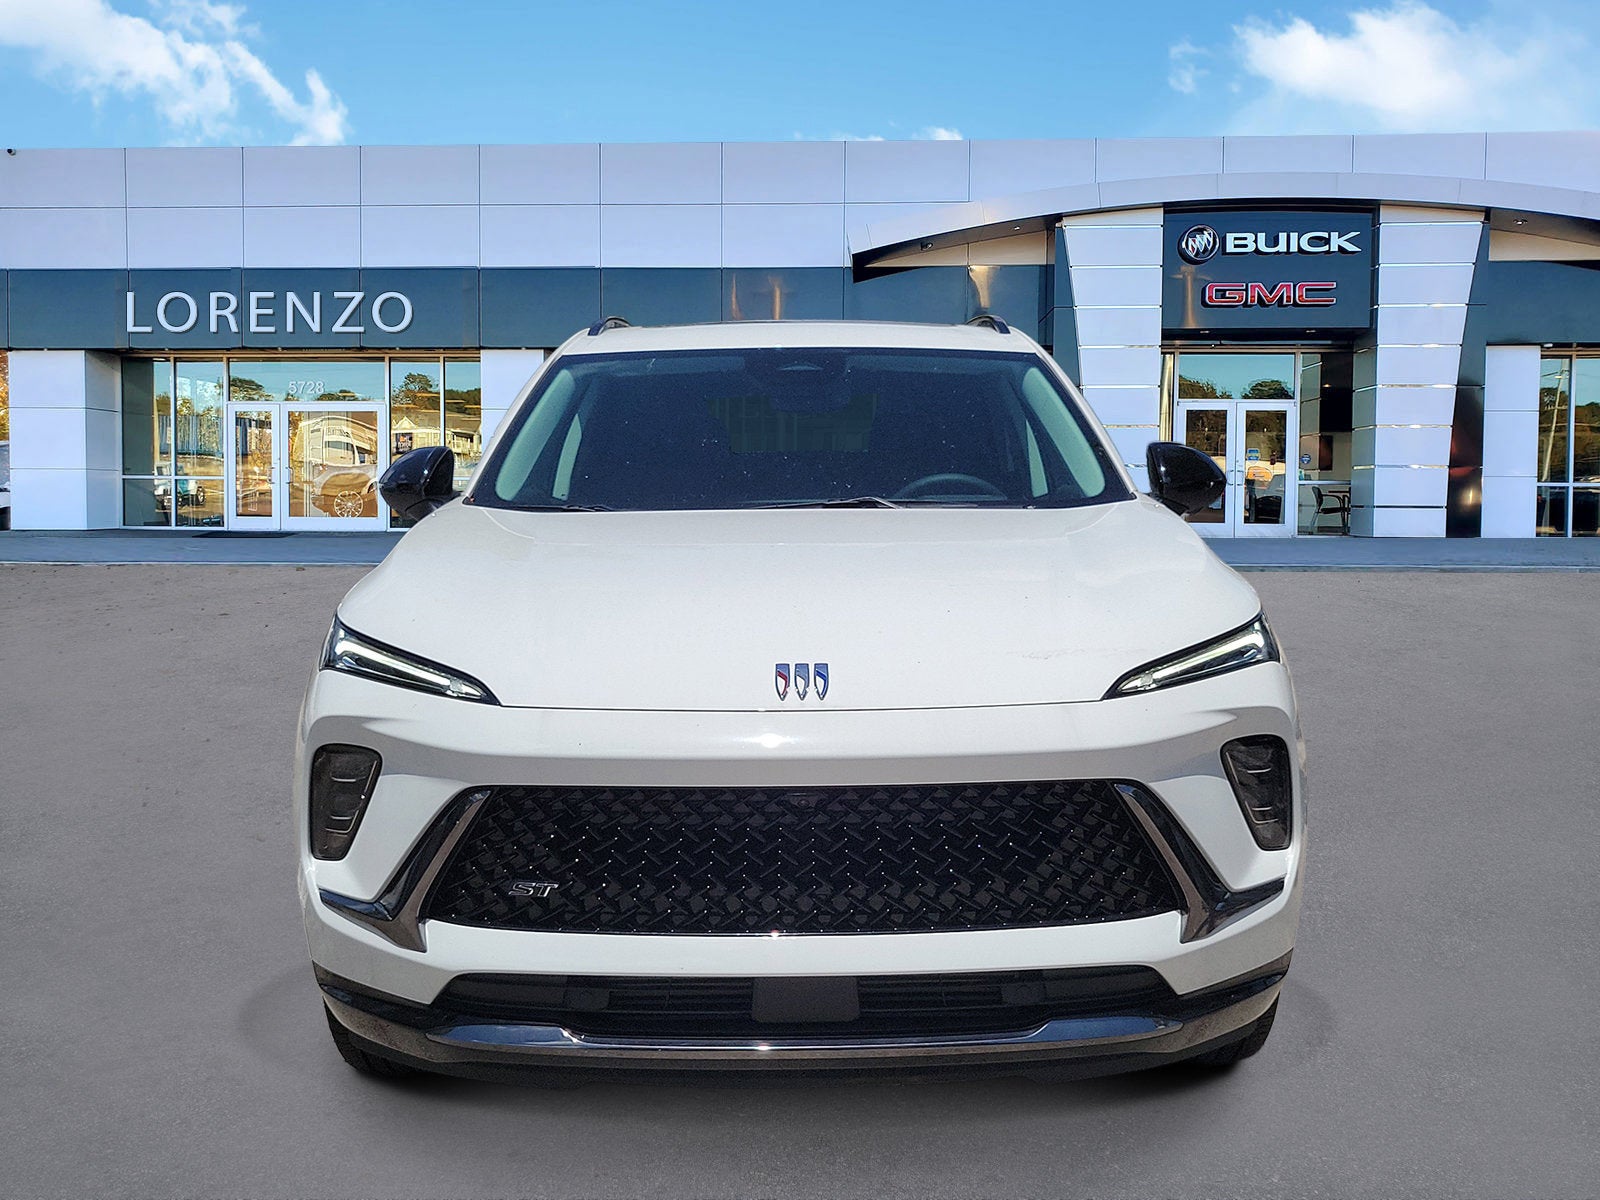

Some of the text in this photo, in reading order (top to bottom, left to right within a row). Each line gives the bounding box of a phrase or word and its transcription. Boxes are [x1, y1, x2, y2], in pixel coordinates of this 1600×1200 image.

[1225, 231, 1362, 253] BUICK
[1206, 282, 1337, 305] GMC
[126, 291, 413, 333] LORENZO
[288, 380, 325, 394] 5728
[508, 881, 559, 897] ST
